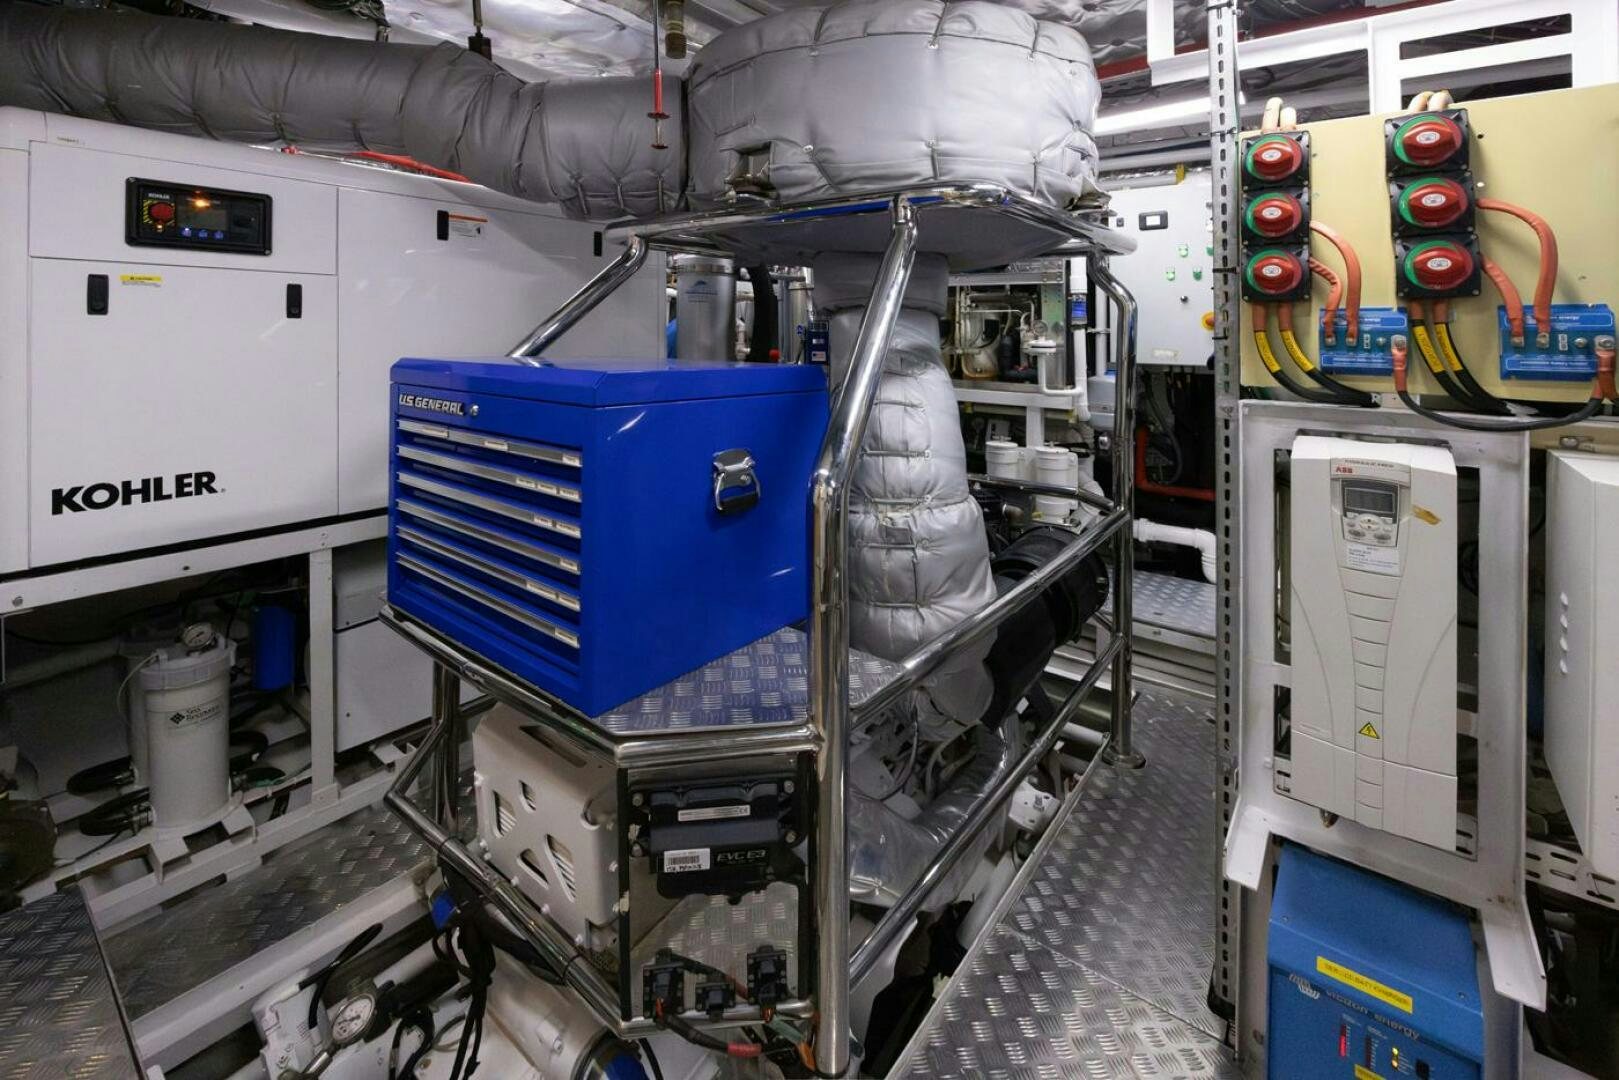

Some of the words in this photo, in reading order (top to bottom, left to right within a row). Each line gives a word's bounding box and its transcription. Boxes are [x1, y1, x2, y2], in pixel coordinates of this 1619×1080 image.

[414, 397, 464, 416] GENERAL
[52, 471, 218, 515] KOHLER
[717, 851, 744, 862] EVC
[747, 848, 766, 859] E3
[1374, 1013, 1420, 1039] energy
